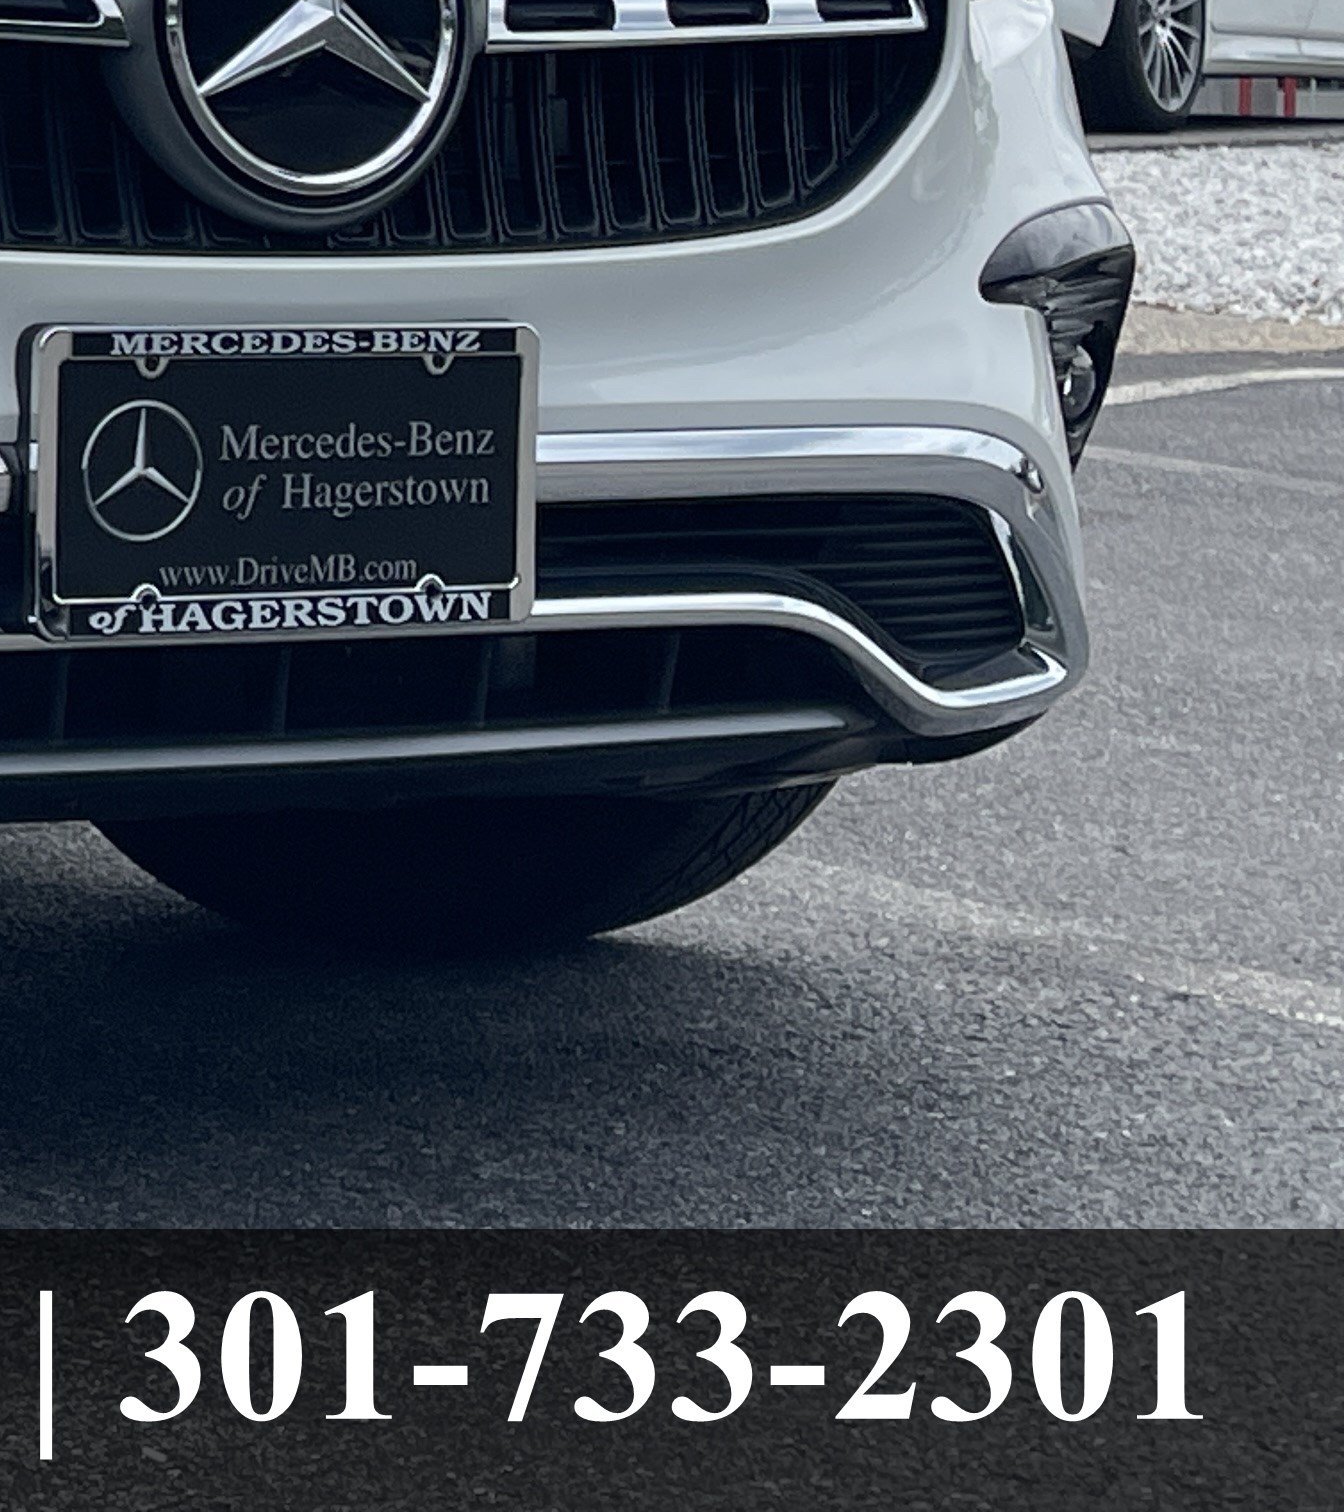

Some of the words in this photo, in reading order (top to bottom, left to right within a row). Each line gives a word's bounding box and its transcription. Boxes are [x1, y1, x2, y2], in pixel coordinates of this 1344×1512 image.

[110, 330, 481, 357] MERCEDES-BENZ
[218, 420, 495, 462] Mercedes-Benz
[222, 474, 267, 519] of
[281, 472, 490, 518] Hagerstown
[158, 554, 418, 589] www.DriveMB.com
[89, 608, 134, 634] of
[138, 592, 493, 634] HAGERSTOWN
